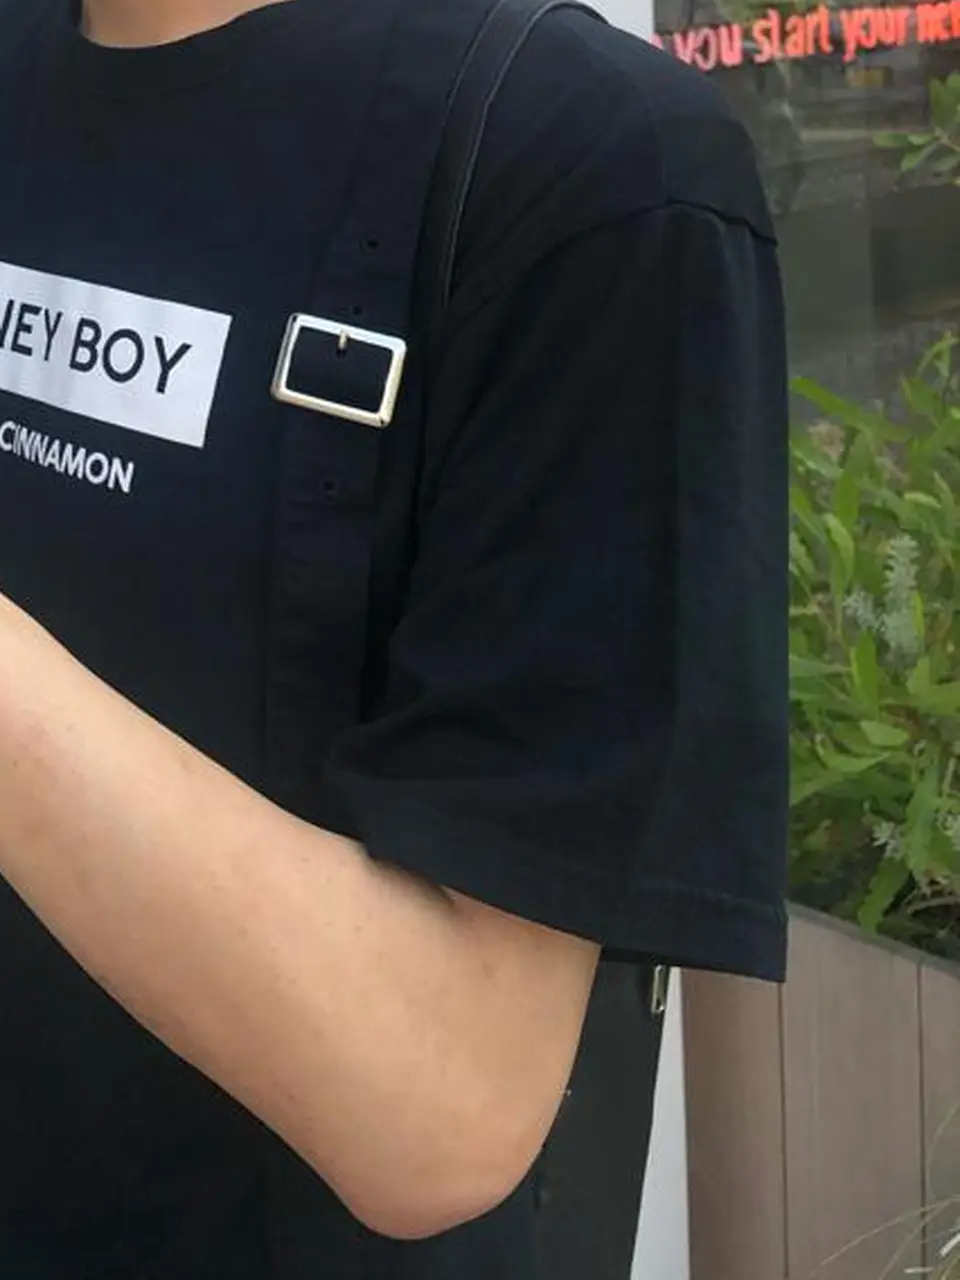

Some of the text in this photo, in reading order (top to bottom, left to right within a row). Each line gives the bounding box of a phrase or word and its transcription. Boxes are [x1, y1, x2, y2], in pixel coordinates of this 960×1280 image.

[672, 22, 744, 70] you
[752, 3, 834, 65] start
[840, 7, 909, 62] your
[69, 317, 193, 394] BOY
